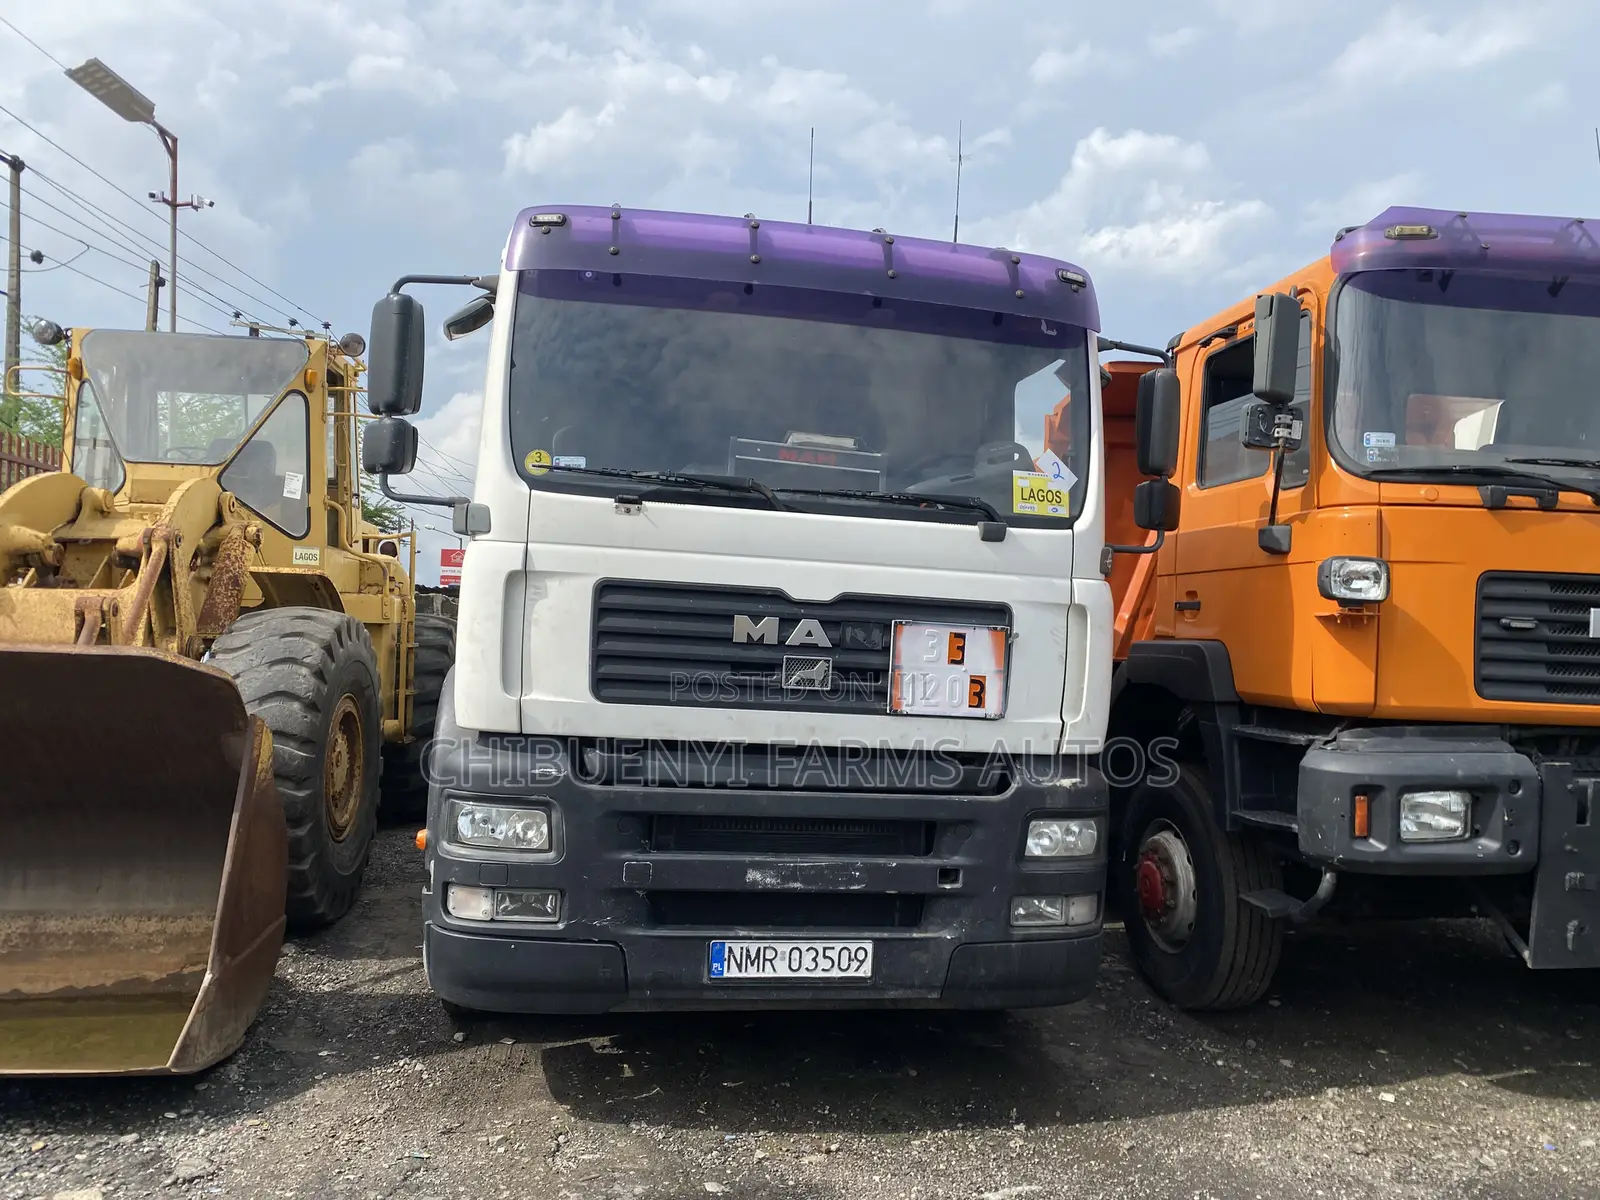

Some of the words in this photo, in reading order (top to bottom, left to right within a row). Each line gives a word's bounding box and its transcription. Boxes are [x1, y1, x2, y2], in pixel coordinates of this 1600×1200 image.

[534, 451, 543, 463] 3
[1052, 461, 1066, 480] 2
[1020, 487, 1062, 504] LAGOS
[294, 551, 318, 562] LAGOS
[712, 962, 723, 971] PL
[726, 946, 778, 973] NMR
[788, 946, 868, 973] 03509
